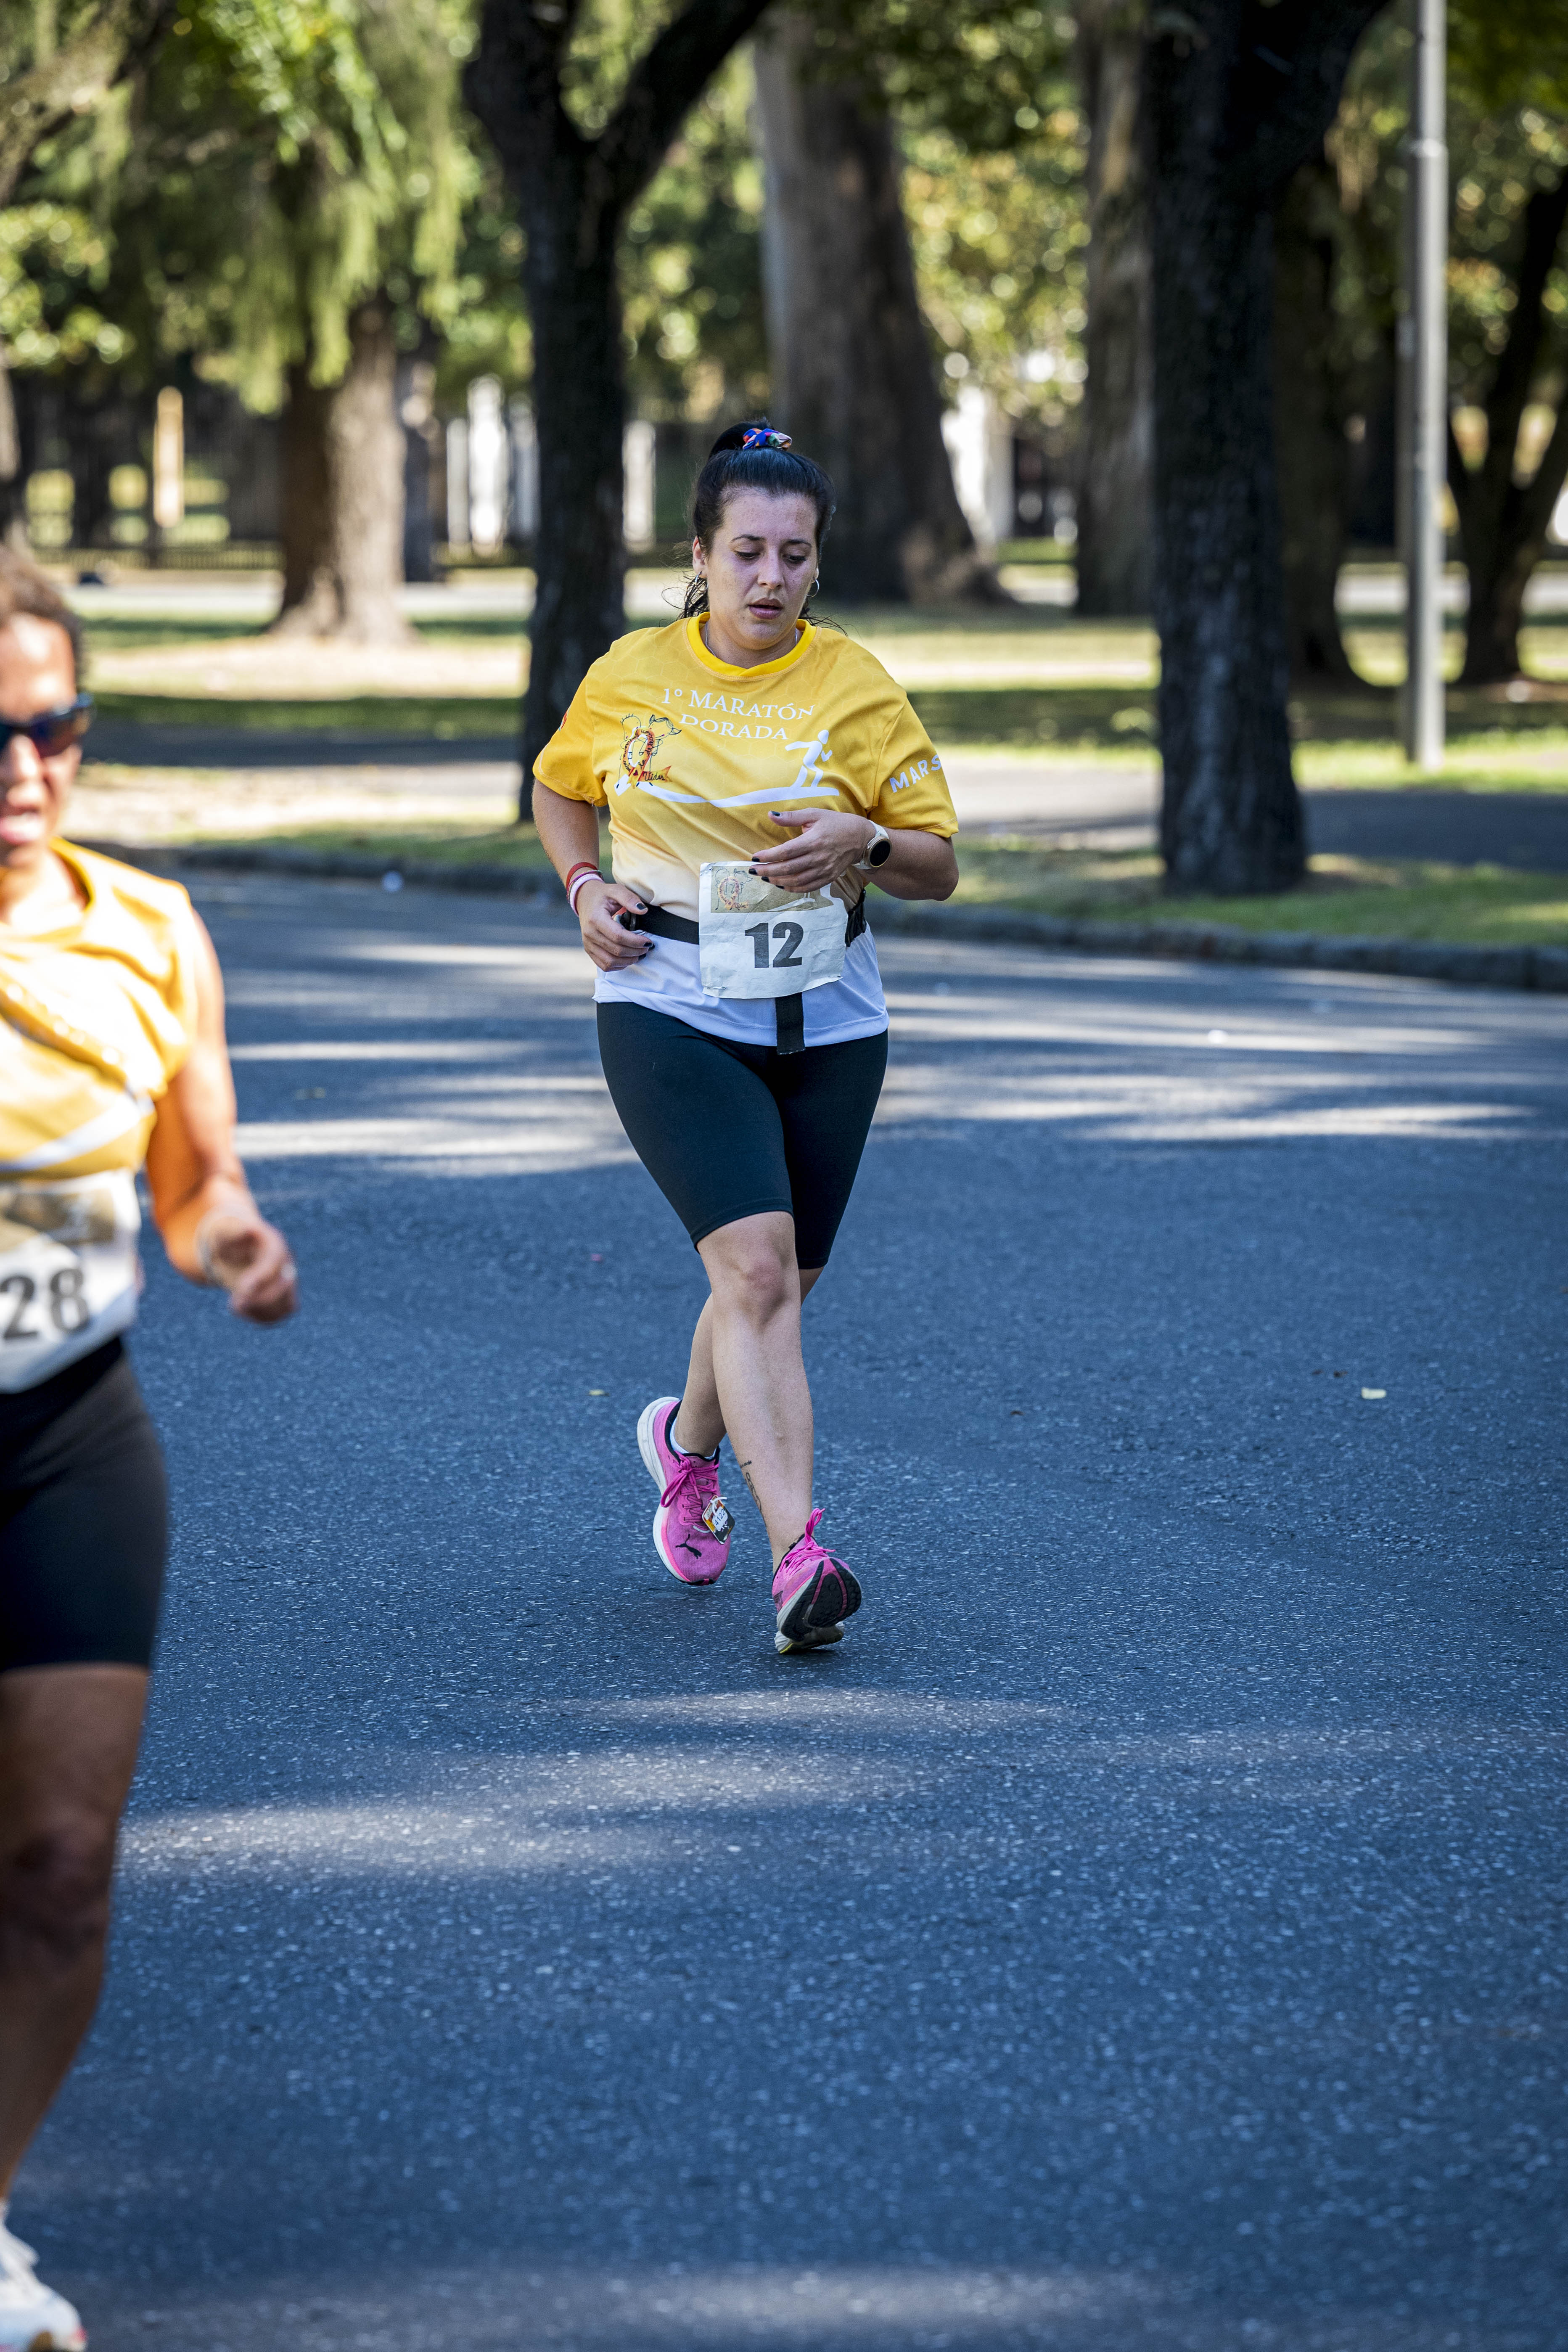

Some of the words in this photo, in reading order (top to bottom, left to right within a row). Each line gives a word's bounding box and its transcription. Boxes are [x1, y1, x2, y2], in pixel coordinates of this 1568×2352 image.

[688, 690, 816, 720] MARATÓN
[679, 714, 789, 740] DORADA
[889, 754, 941, 793] MARS
[745, 922, 804, 968] 12
[0, 1269, 90, 1339] 28
